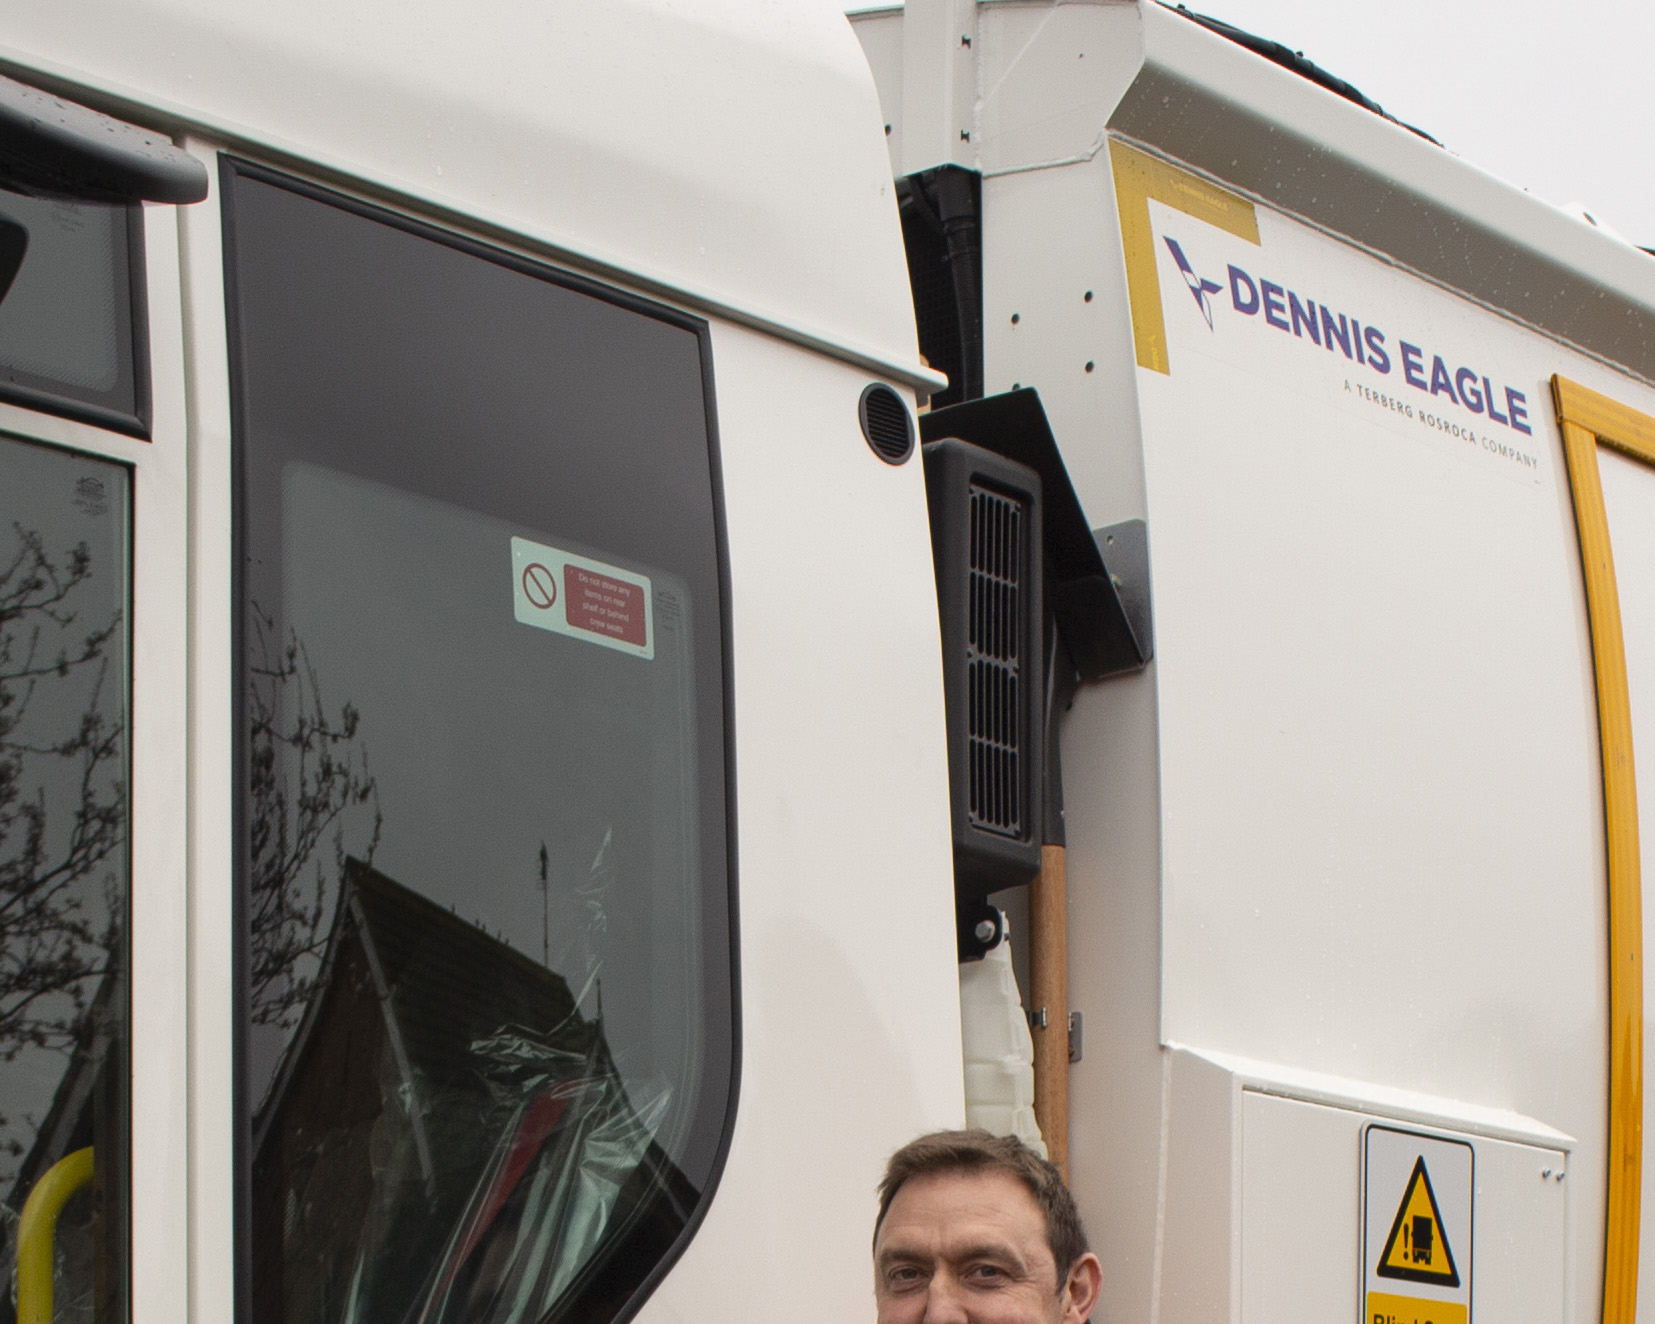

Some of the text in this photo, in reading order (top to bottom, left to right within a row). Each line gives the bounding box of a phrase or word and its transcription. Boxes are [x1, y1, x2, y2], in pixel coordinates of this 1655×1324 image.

[1227, 263, 1532, 436] DENNIS EAGLE
[1343, 378, 1539, 470] A TERBERG ROSROCA COMPANY
[578, 572, 589, 584] Do
